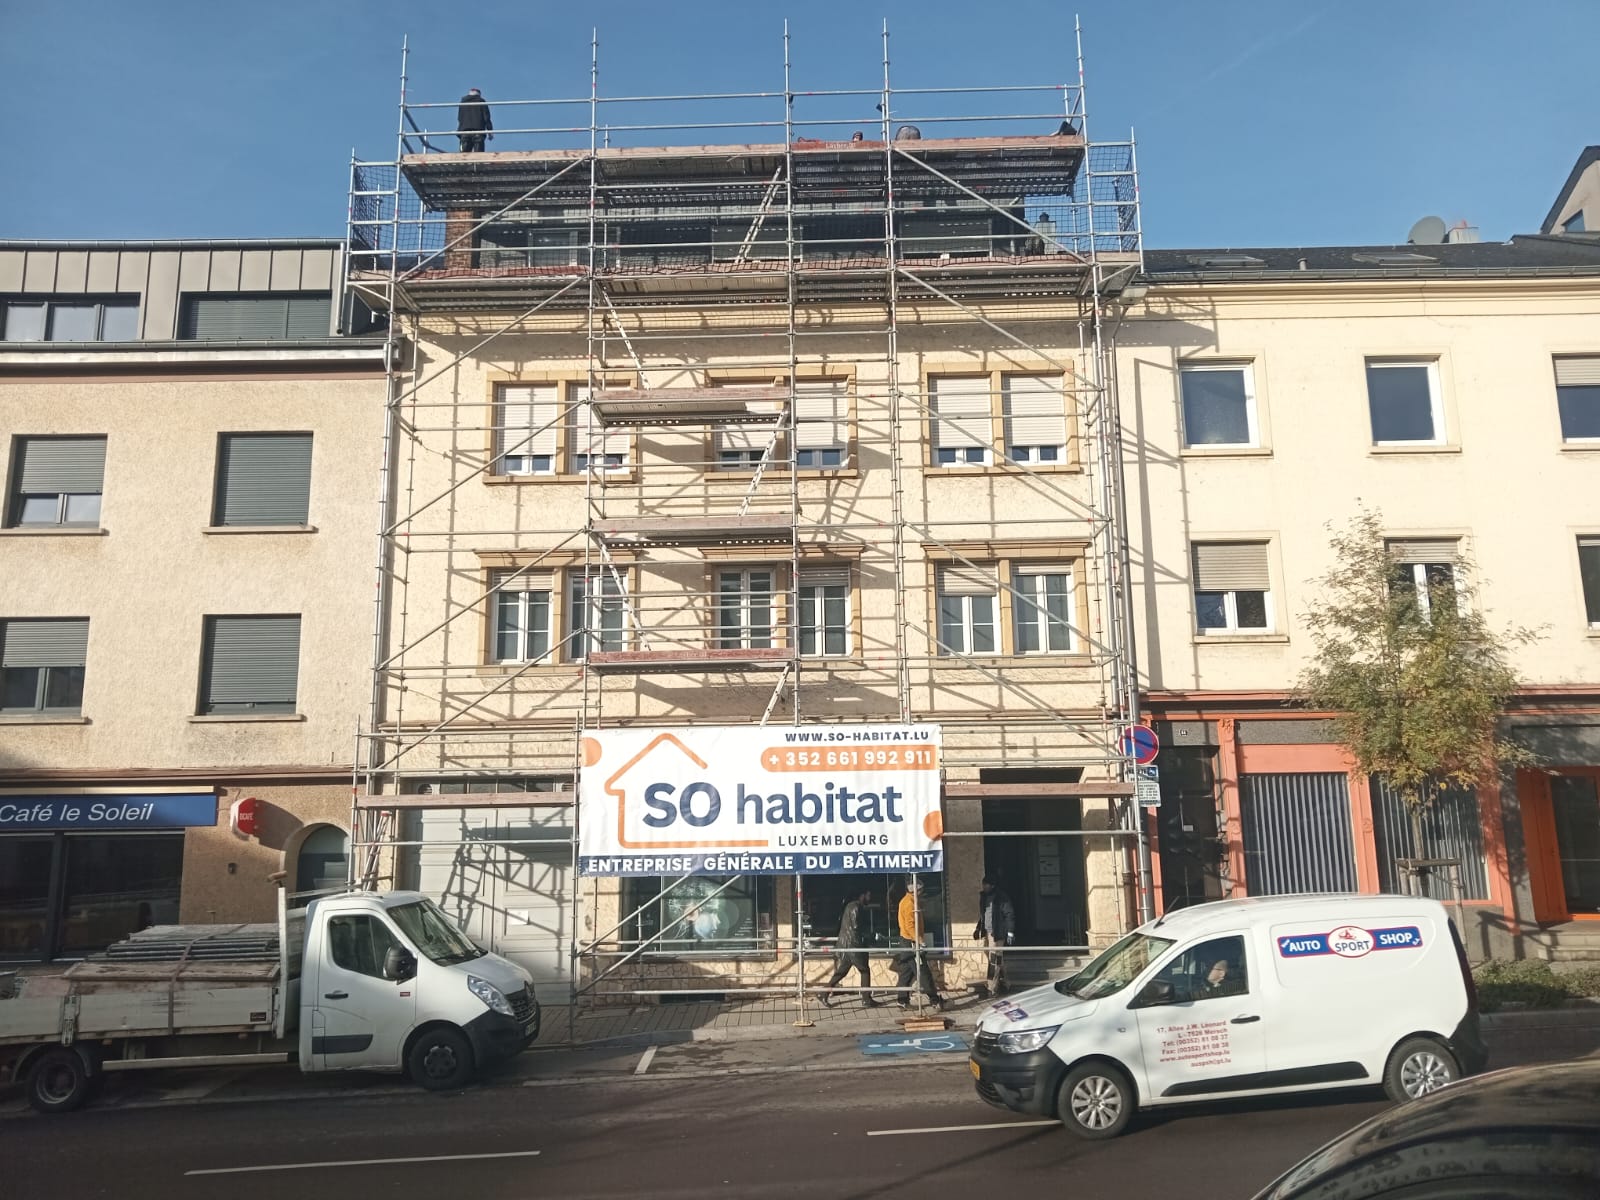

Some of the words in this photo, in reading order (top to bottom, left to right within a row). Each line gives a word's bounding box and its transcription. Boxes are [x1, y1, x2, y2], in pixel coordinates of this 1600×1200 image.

[785, 731, 929, 742] WWW.SO-HABITAT.LU
[786, 751, 820, 766] 352
[827, 751, 858, 766] 661
[865, 751, 898, 765] 992
[905, 750, 931, 765] 911
[0, 803, 53, 822] Café
[60, 803, 80, 821] le
[88, 802, 155, 822] Soleil
[642, 781, 721, 828] SO
[737, 781, 903, 825] habitat
[778, 833, 889, 847] LUXEMBOURG
[588, 857, 692, 873] ENTREPRISE
[704, 851, 794, 871] GÉNÉRALE
[805, 855, 831, 870] DU
[843, 851, 934, 869] BÂTIMENT
[1289, 940, 1321, 952] AUTO
[1334, 940, 1370, 952] SPORT
[1380, 932, 1413, 945] SHOP
